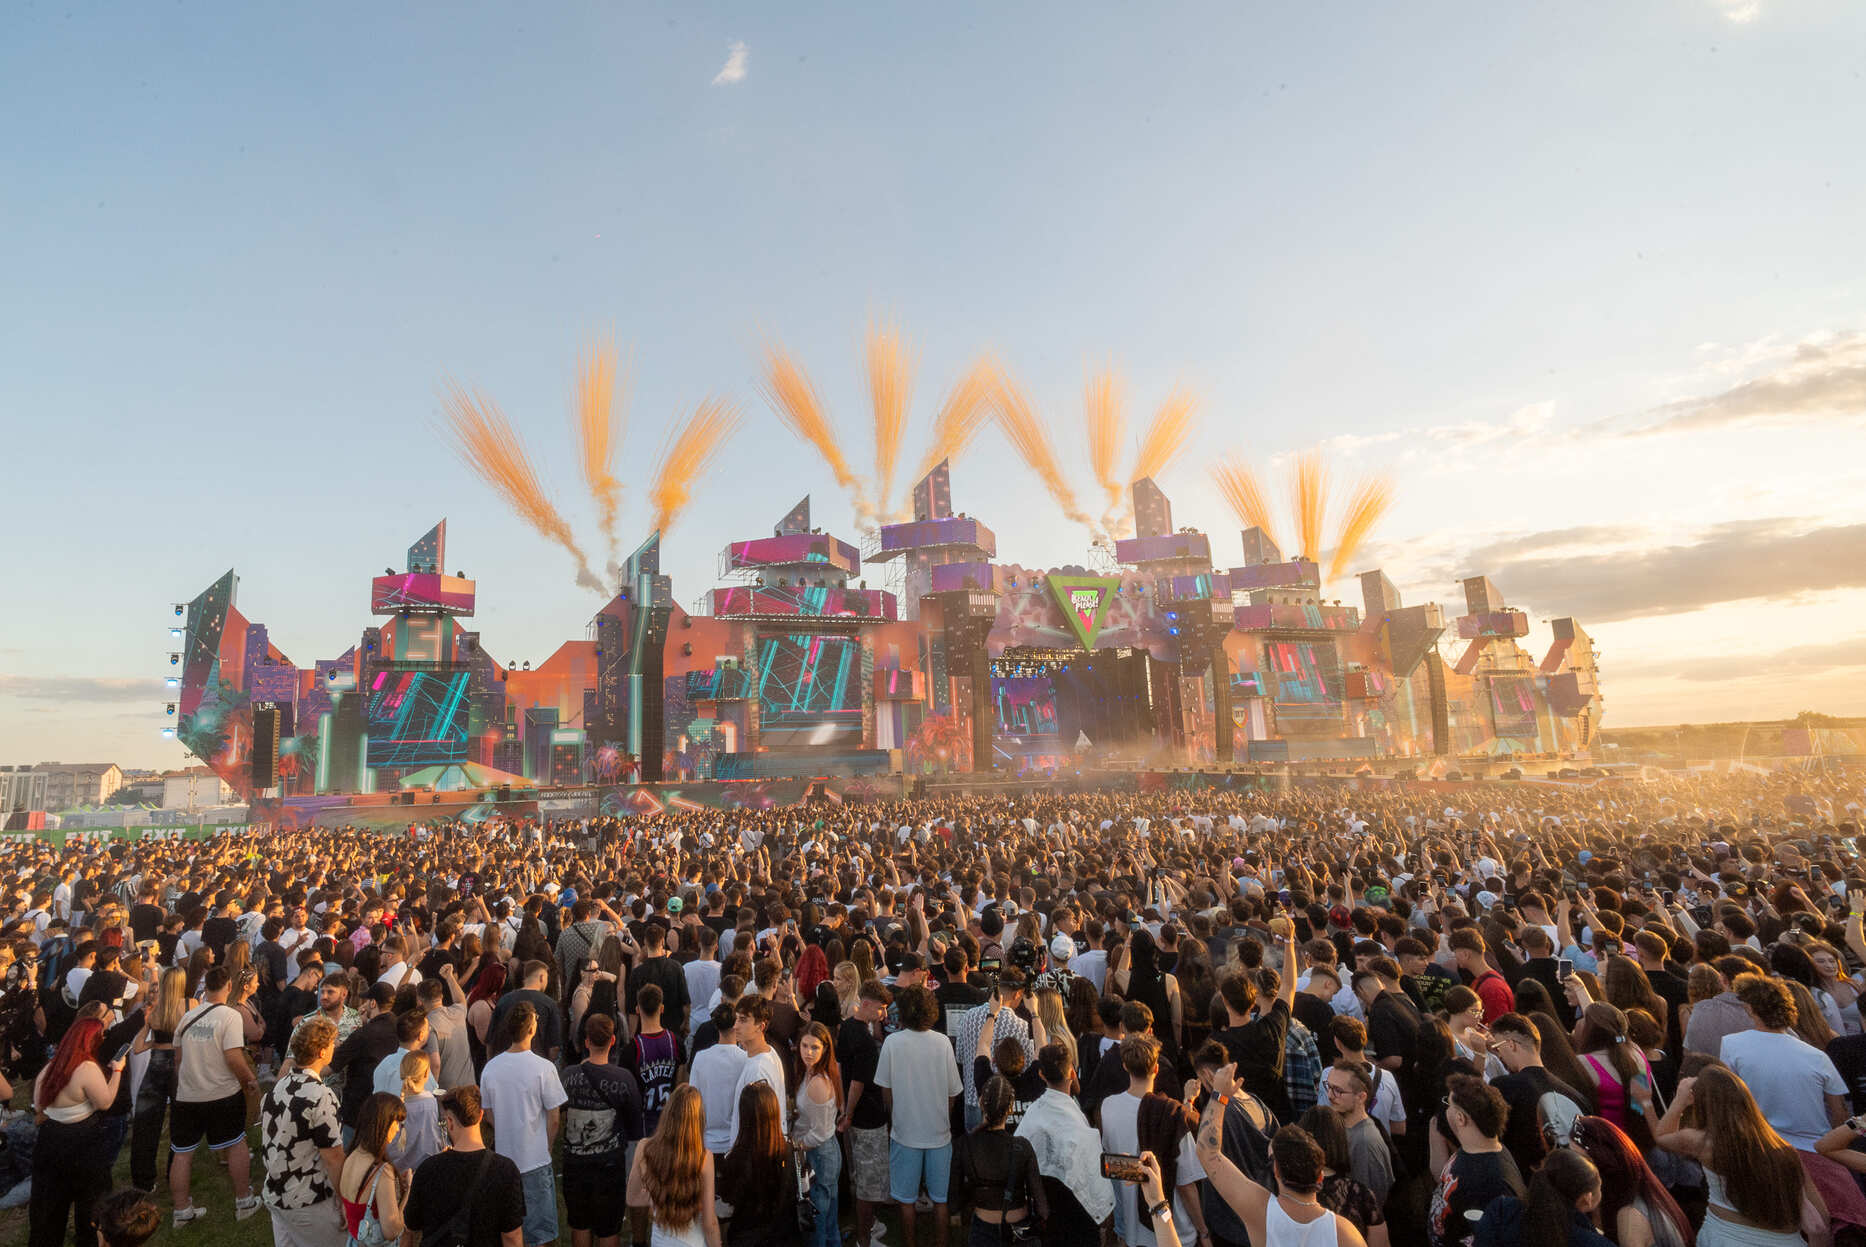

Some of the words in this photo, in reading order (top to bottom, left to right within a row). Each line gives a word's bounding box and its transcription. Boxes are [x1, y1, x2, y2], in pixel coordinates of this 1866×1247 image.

[0, 833, 35, 844] XIT
[65, 830, 112, 842] EXIT
[142, 828, 186, 841] EXIT
[640, 1065, 675, 1084] CARTER
[646, 1083, 672, 1111] 15
